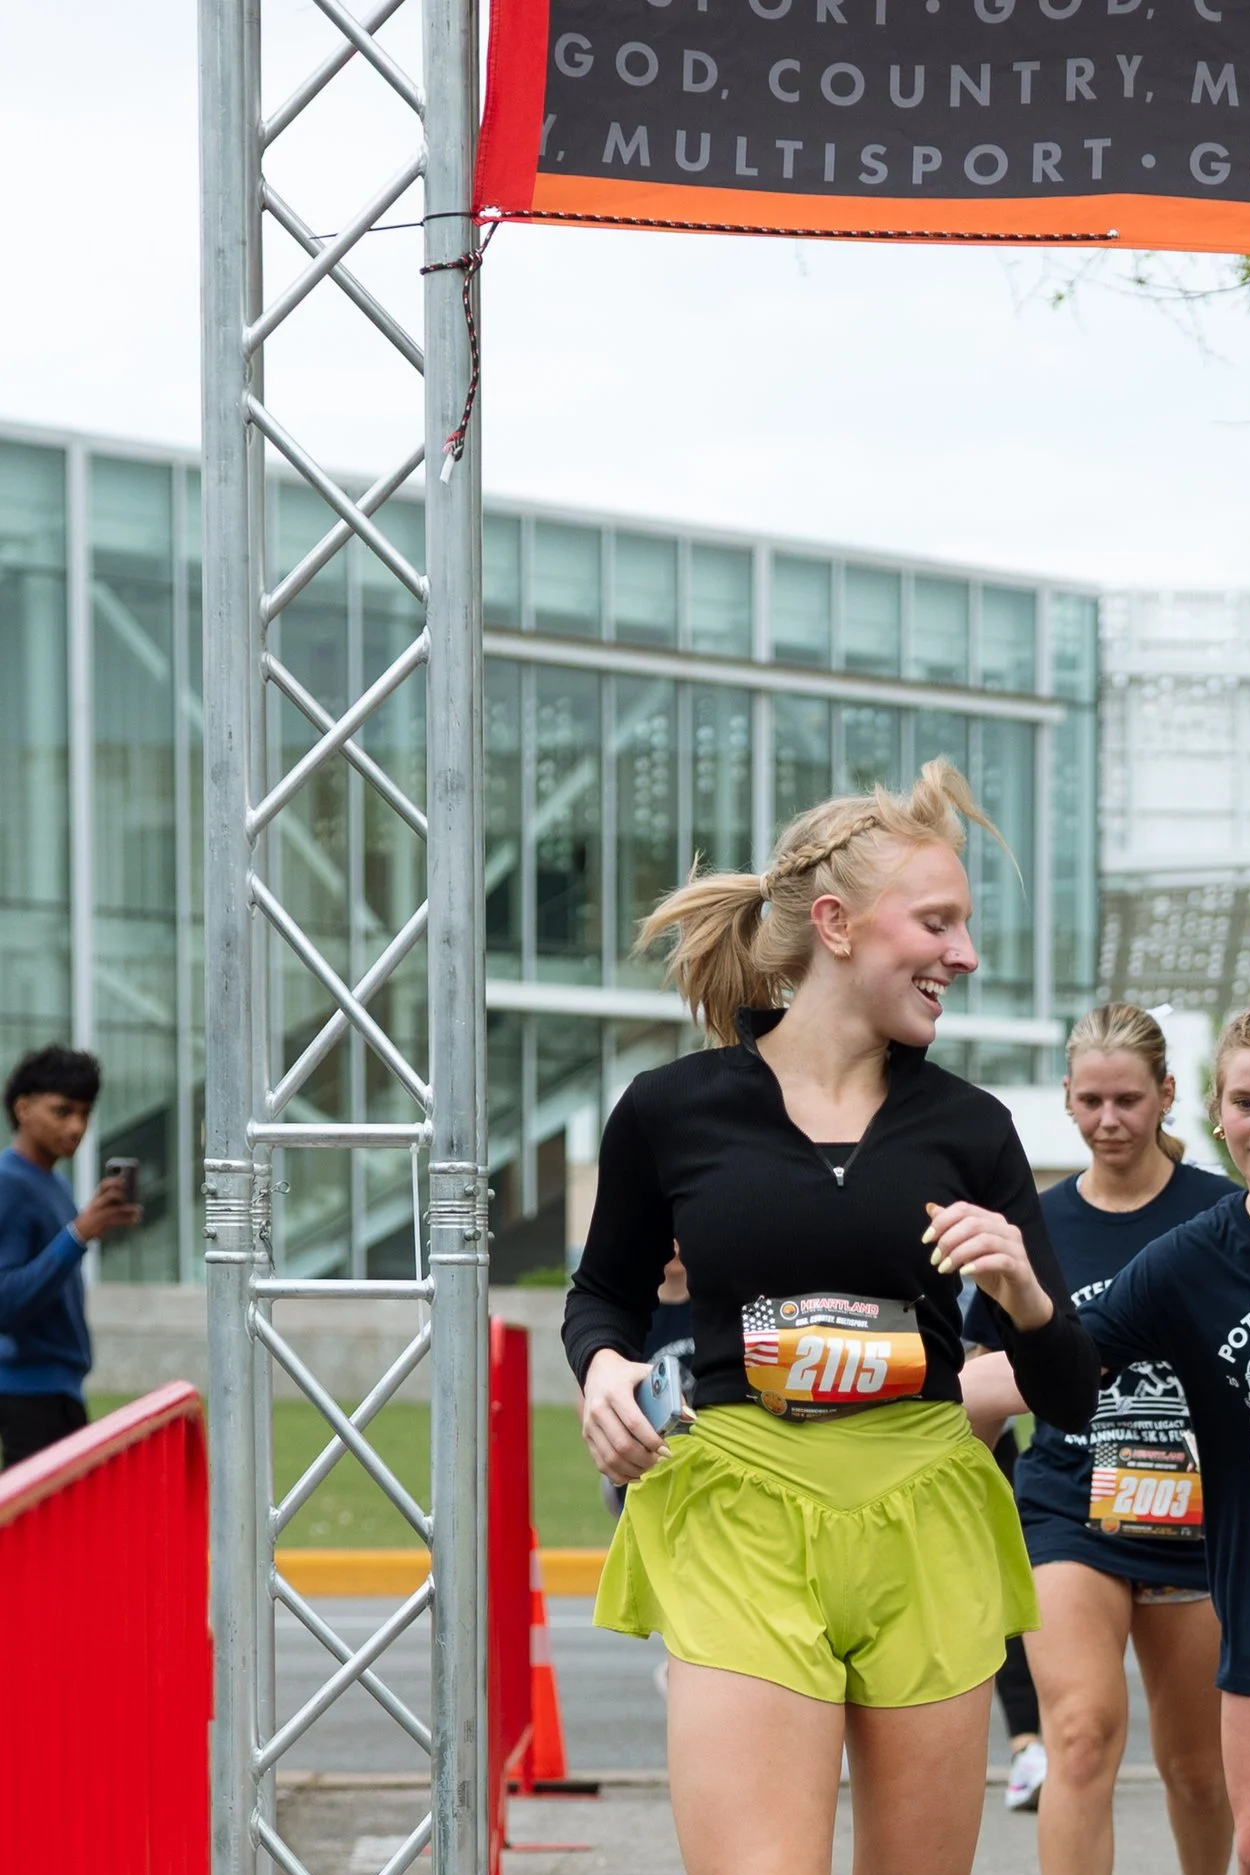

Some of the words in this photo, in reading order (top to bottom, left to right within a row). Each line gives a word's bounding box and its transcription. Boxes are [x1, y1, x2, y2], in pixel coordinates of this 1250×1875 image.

[554, 32, 729, 100] GOD,
[768, 54, 1153, 107] COUNTRY,
[602, 121, 1111, 185] MULTISPORT
[801, 1298, 879, 1315] HEARTLAND
[785, 1335, 891, 1393] 2115
[1090, 1428, 1140, 1445] ANNUAL
[1112, 1476, 1192, 1518] 2003
